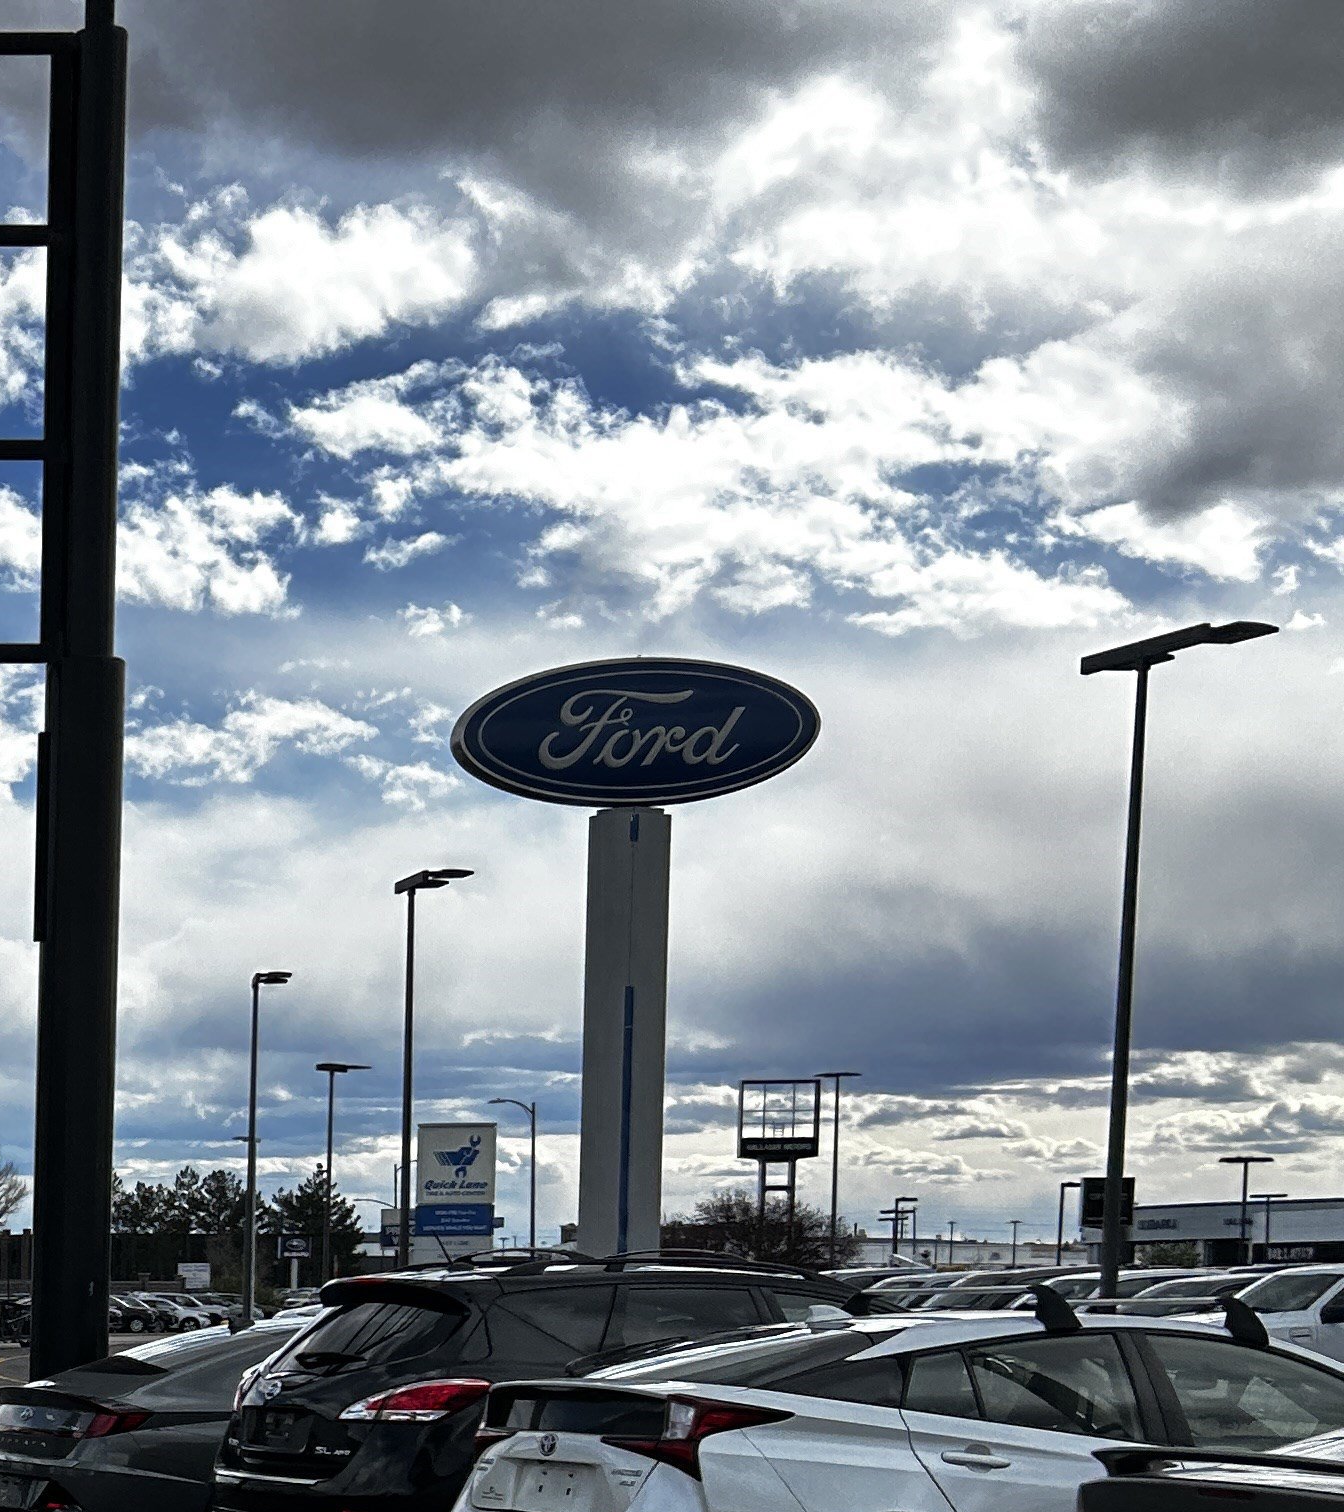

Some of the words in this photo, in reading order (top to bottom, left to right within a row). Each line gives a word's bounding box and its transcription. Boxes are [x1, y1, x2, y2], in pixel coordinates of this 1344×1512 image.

[538, 689, 746, 770] Ford
[424, 1180, 458, 1190] Quick
[459, 1180, 488, 1189] Lane
